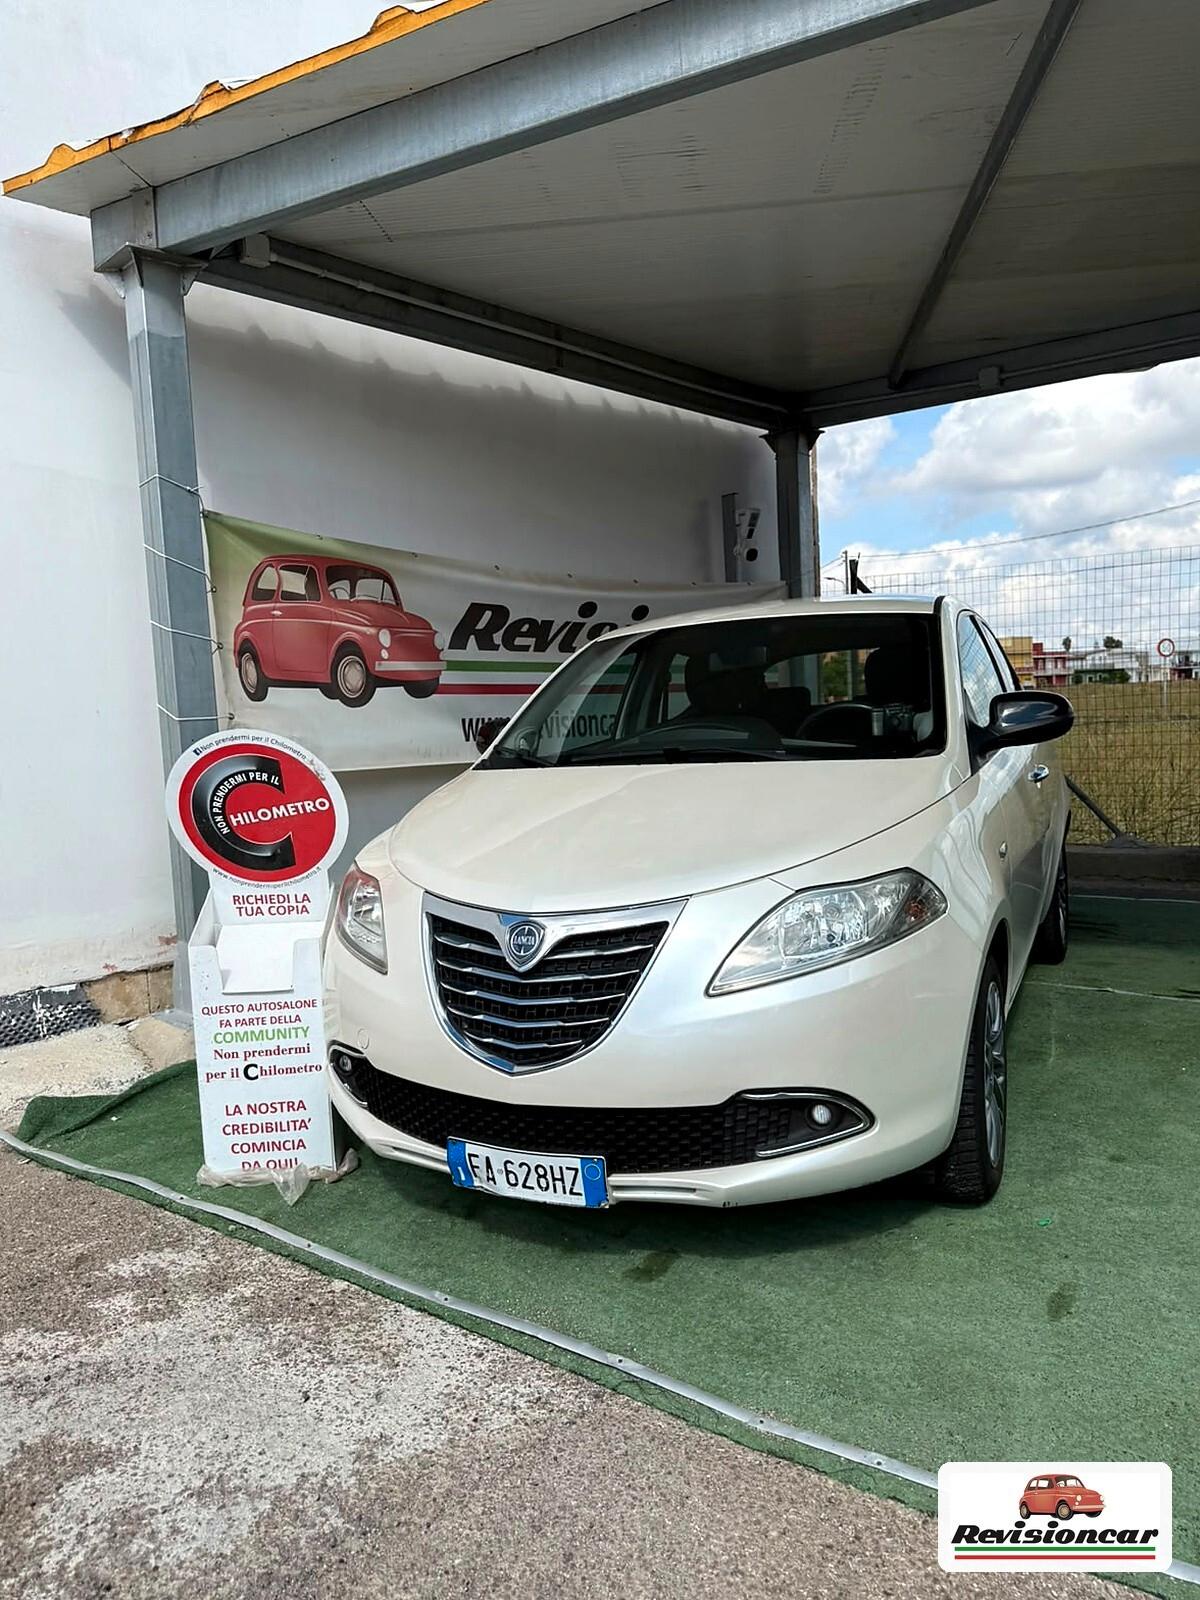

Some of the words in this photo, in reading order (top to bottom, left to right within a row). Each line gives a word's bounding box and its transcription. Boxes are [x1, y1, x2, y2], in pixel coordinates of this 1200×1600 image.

[215, 734, 250, 746] prendermi
[270, 738, 307, 760] Chilometro
[249, 772, 269, 782] PER
[270, 775, 280, 786] IL
[213, 773, 248, 813] PRENDERMI
[215, 814, 230, 835] NON
[232, 893, 291, 906] RICHIEDI
[295, 893, 311, 904] LA
[236, 905, 266, 917] TUA
[268, 904, 310, 916] COPIA
[201, 1004, 244, 1017] QUESTO
[247, 999, 318, 1012] AUTOSALONE
[219, 1019, 232, 1029] FA
[235, 1017, 267, 1027] PARTE
[270, 1014, 302, 1025] DELLA
[213, 1026, 310, 1044] COMMUNITY
[213, 1049, 239, 1060] Non
[243, 1043, 311, 1061] prendermi
[205, 1071, 227, 1083] per
[230, 1068, 239, 1078] il
[243, 1063, 323, 1081] Chilometro
[224, 1103, 243, 1117] LA
[246, 1100, 307, 1115] NOSTRA
[230, 1138, 307, 1155] COMINCIA
